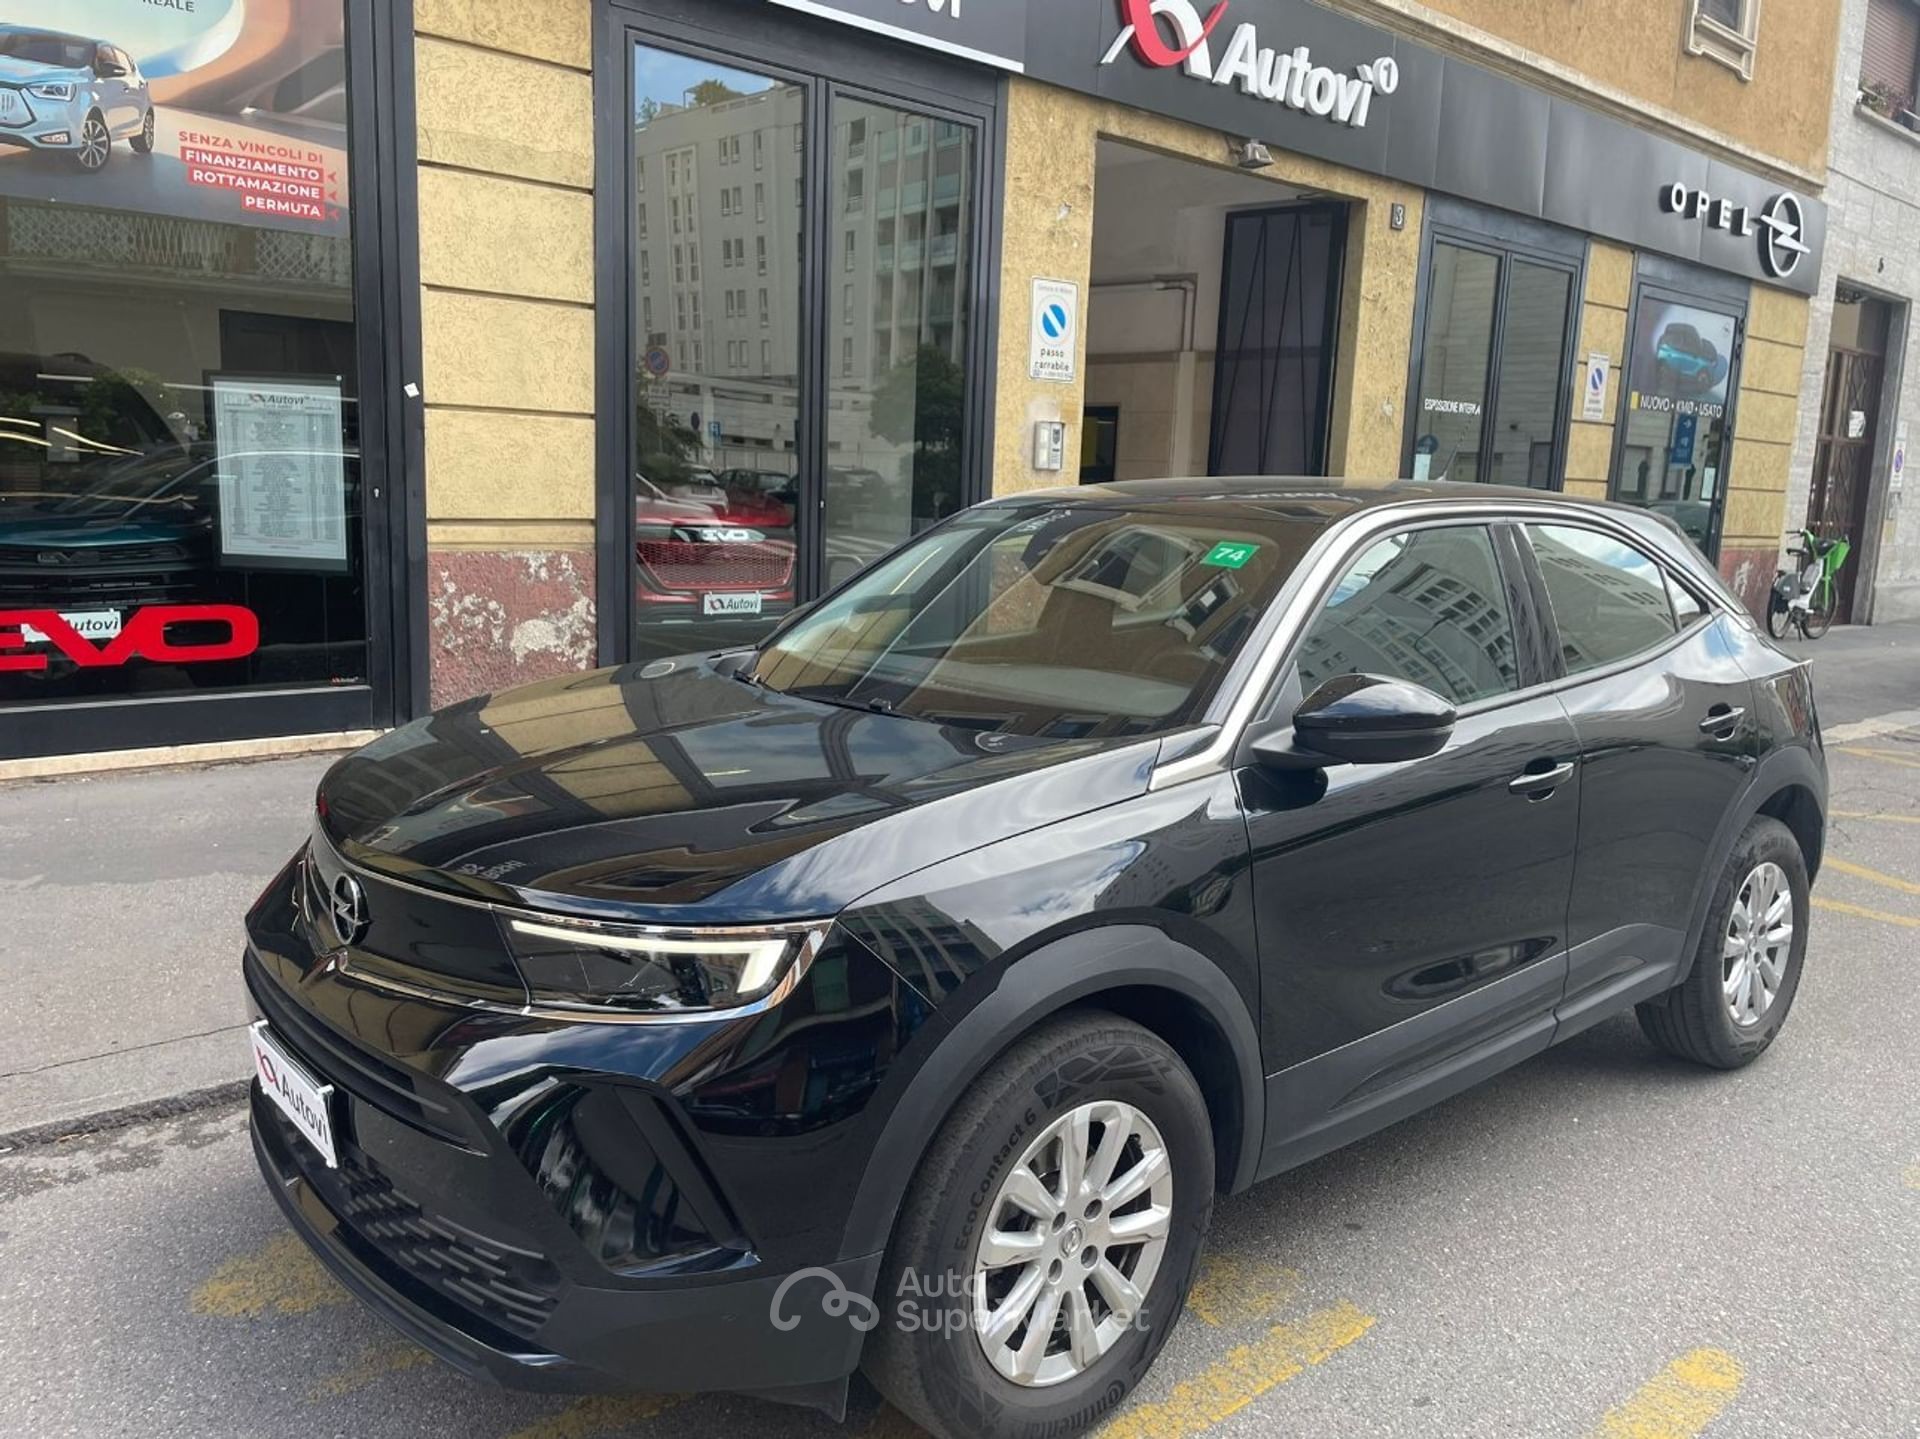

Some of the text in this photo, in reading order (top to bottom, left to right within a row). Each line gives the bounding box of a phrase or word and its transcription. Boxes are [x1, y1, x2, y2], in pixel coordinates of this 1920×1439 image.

[179, 131, 323, 163] SENZA VINCOLI DI
[185, 150, 320, 180] FINANZIAMENTO
[193, 169, 320, 199] ROTTAMAZIONE
[246, 196, 321, 217] PERMUTA
[1394, 205, 1404, 226] 3
[1667, 181, 1753, 237] OPEL
[1040, 348, 1065, 358] passo
[1034, 361, 1070, 372] carrabile
[1640, 394, 1670, 411] NUOVO
[1699, 403, 1723, 418] USATO
[1215, 547, 1246, 561] 74
[66, 617, 119, 632] utovì
[954, 1107, 1036, 1250] EcoContact 6
